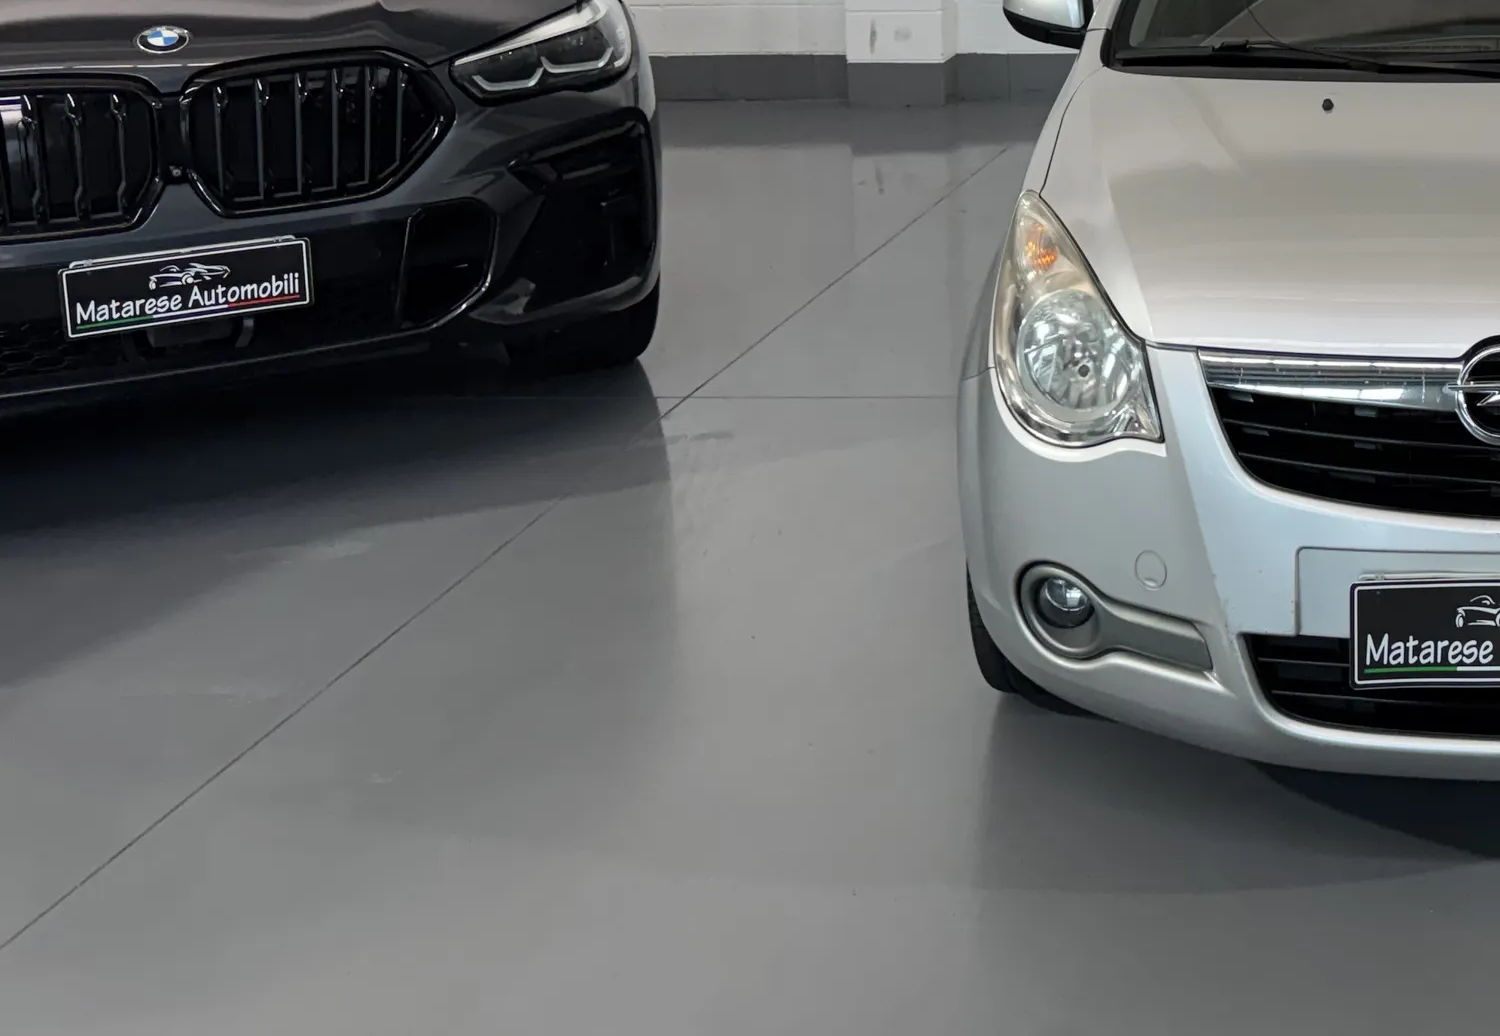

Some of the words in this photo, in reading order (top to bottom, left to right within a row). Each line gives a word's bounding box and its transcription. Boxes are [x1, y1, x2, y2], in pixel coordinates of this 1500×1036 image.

[76, 294, 183, 324] Matarese
[188, 272, 300, 308] Automobili
[1366, 633, 1494, 666] Matarese
